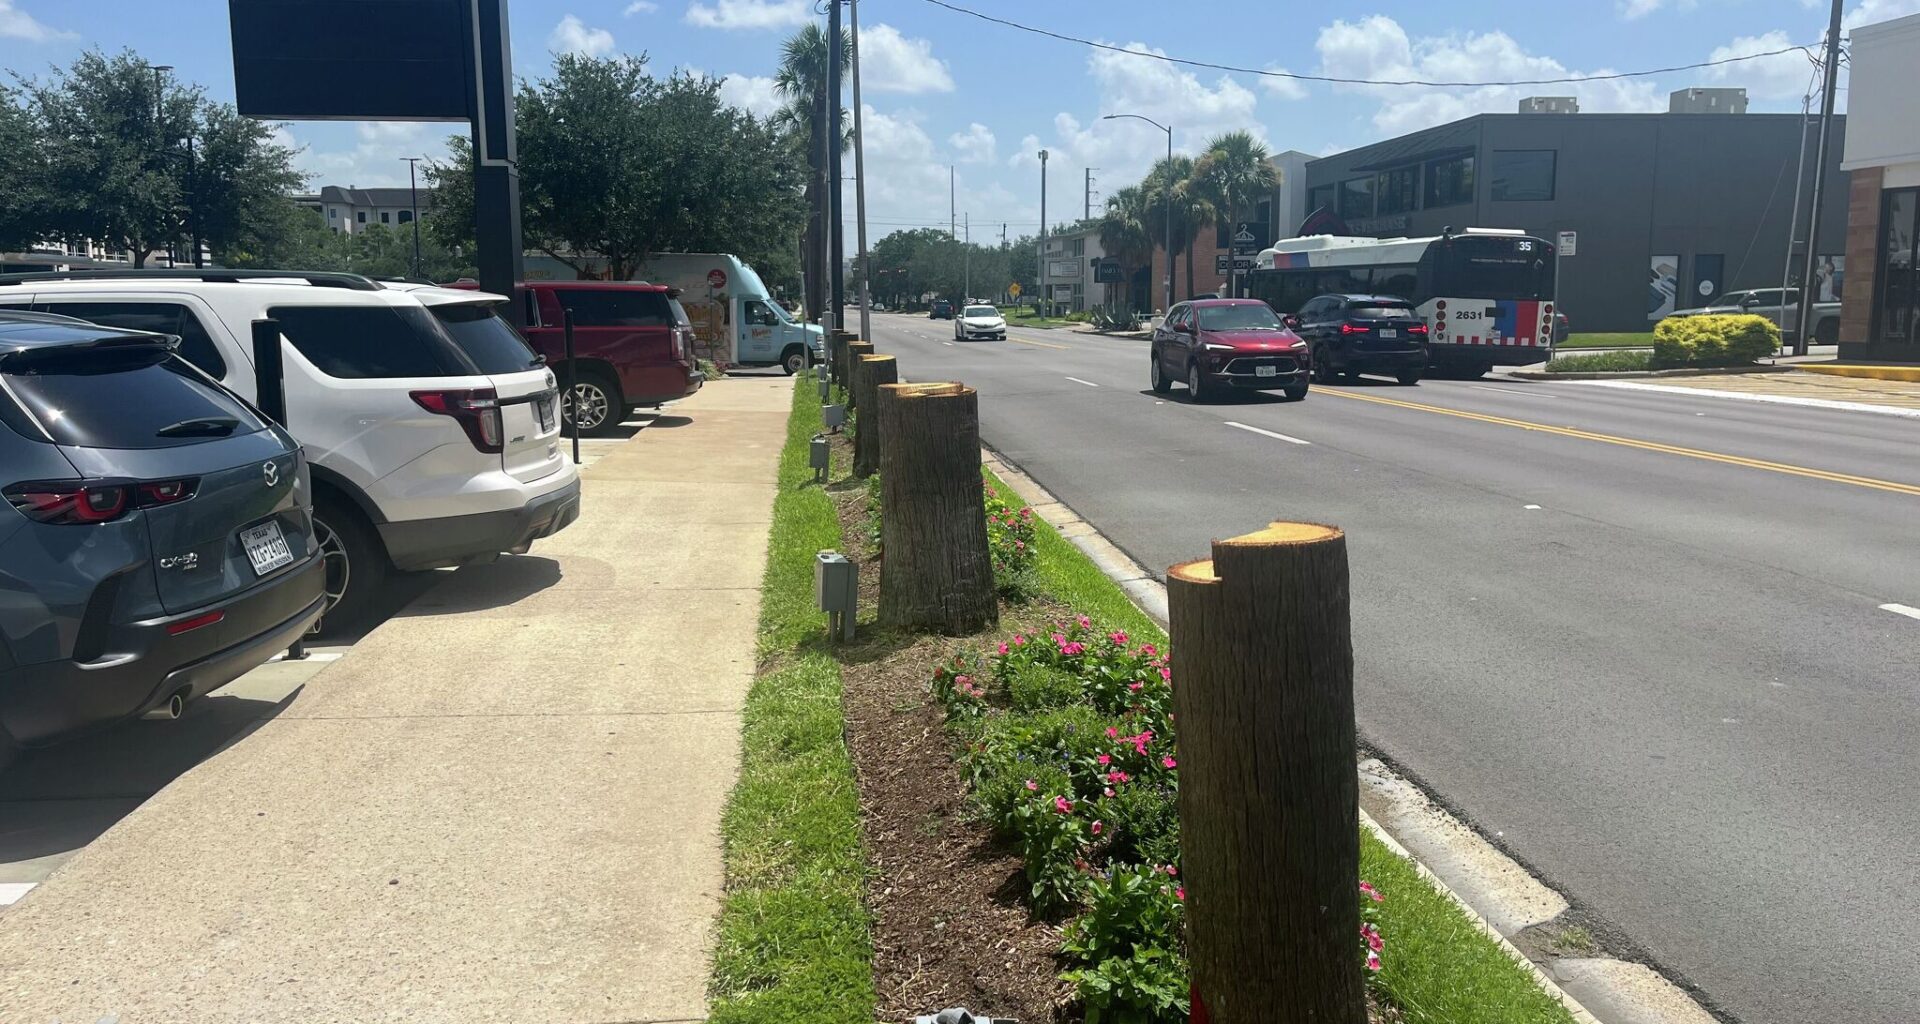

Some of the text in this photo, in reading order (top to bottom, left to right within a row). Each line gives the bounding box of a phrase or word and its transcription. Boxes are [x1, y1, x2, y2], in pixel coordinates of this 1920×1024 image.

[1519, 241, 1532, 251] 35
[1456, 311, 1482, 320] 2631
[252, 529, 268, 540] TEXAS
[160, 552, 198, 568] CX-50
